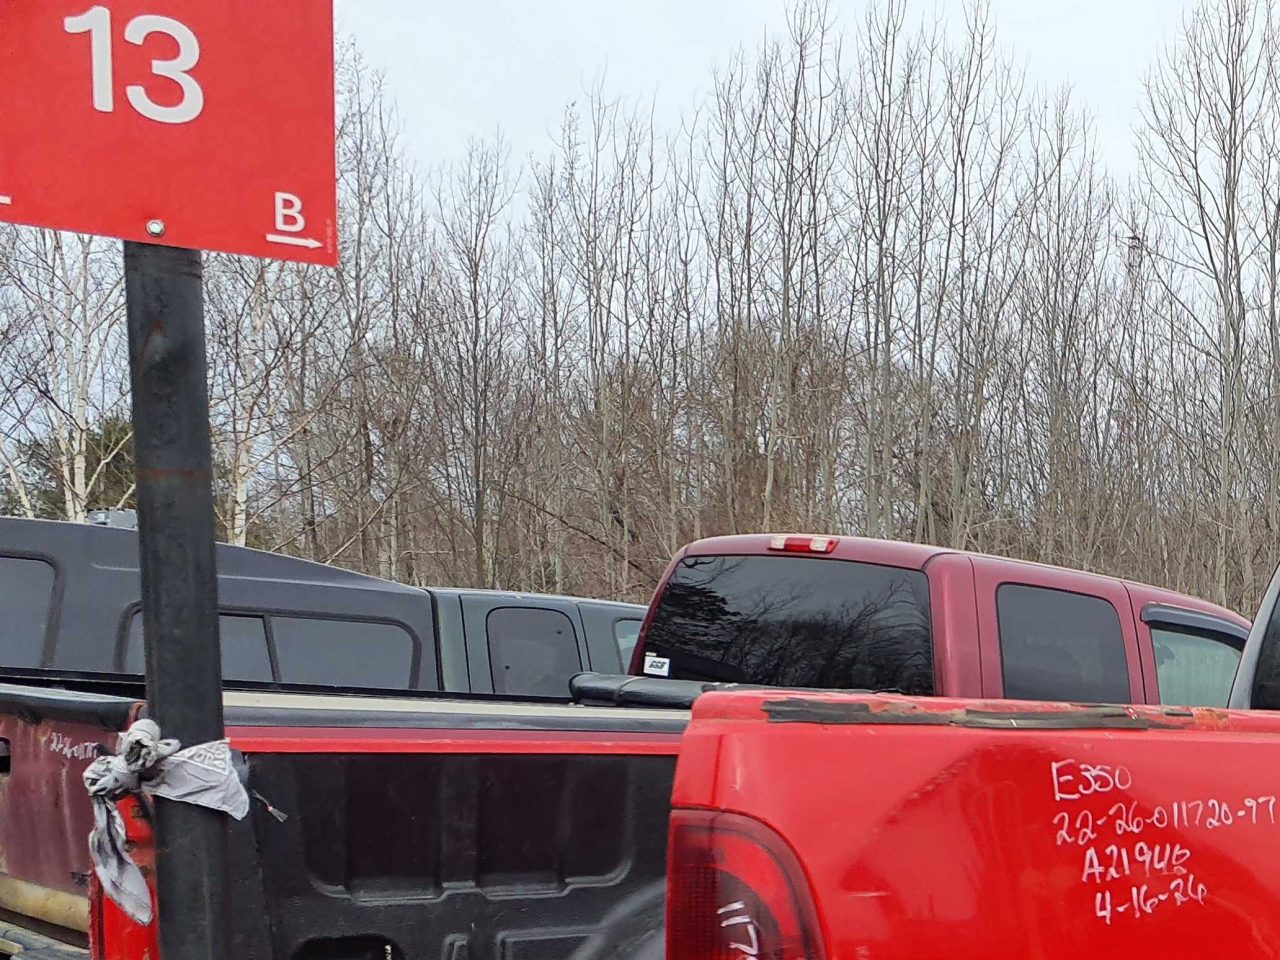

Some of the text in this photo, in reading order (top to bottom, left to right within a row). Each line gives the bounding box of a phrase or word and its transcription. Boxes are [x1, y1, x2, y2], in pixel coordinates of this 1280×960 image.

[63, 5, 204, 124] 13
[274, 191, 306, 232] B
[1052, 759, 1132, 801] E350
